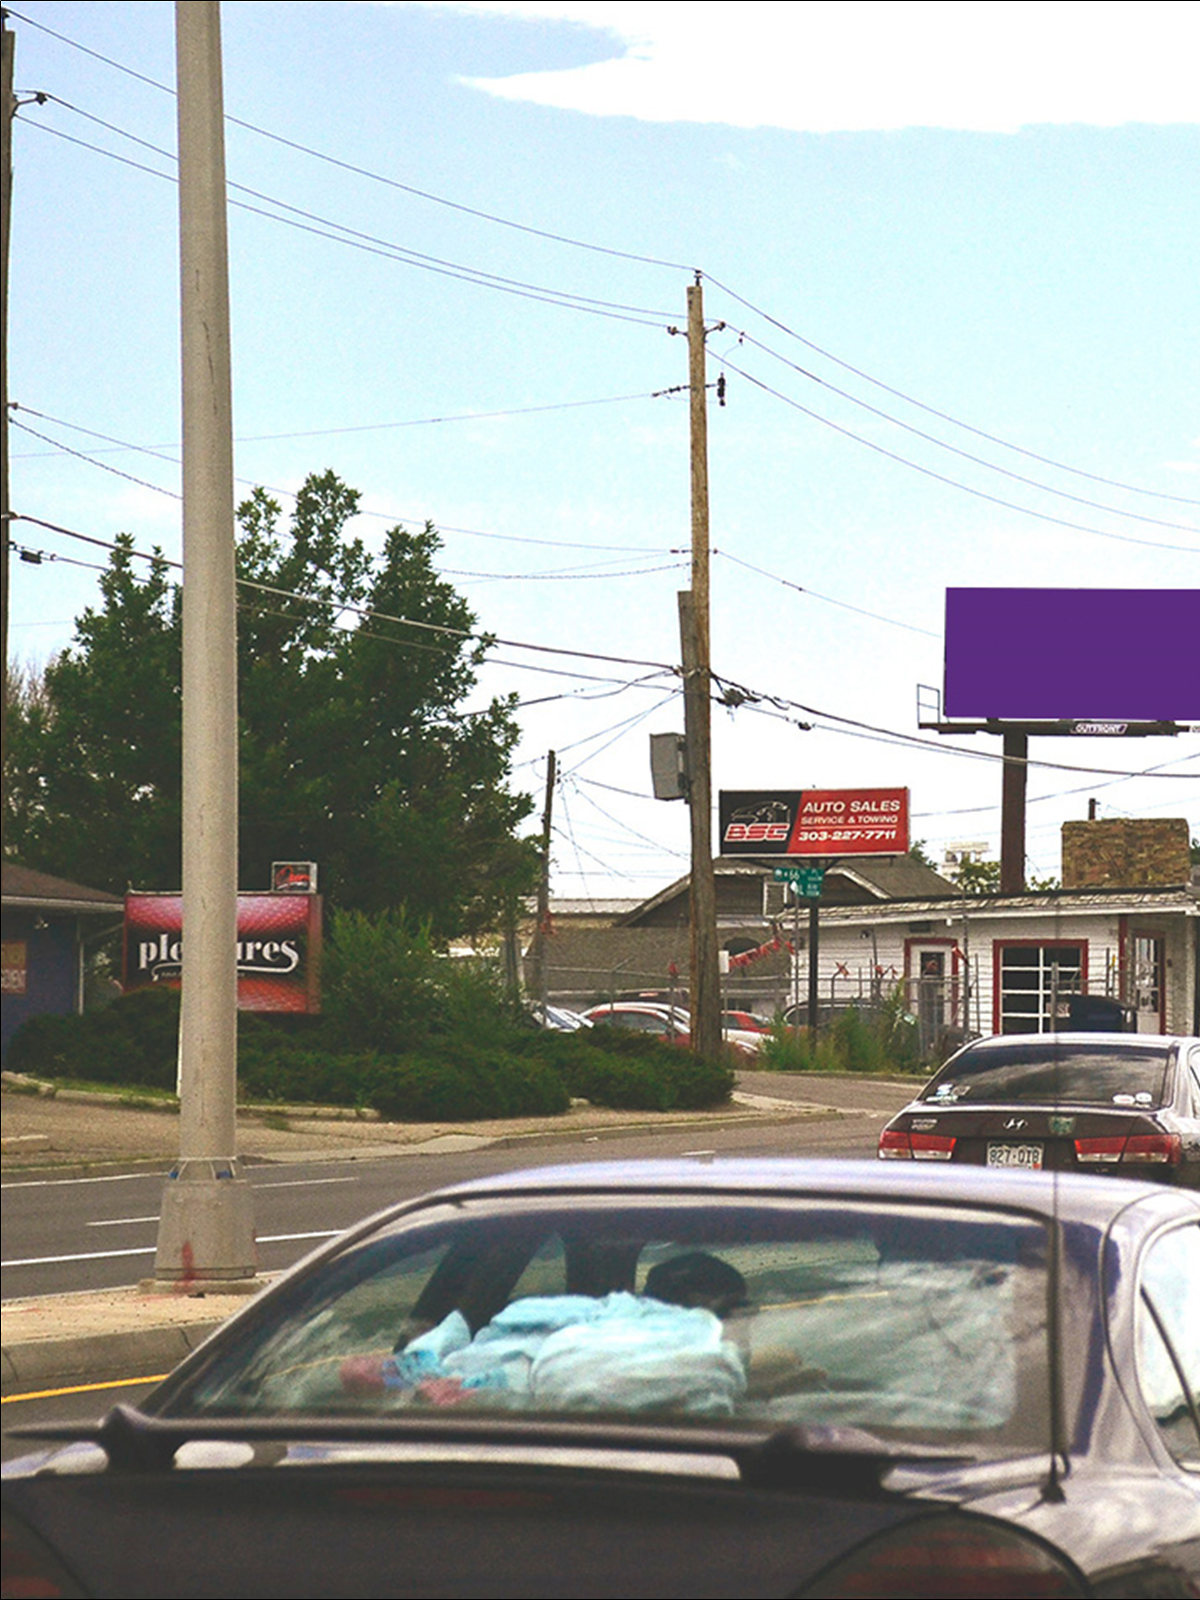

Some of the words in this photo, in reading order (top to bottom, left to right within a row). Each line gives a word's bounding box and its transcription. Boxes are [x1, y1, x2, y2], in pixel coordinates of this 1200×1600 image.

[803, 802, 846, 814] AUTO
[850, 800, 901, 812] SALES
[801, 816, 845, 825] SERVICE
[847, 816, 855, 824] &
[858, 815, 898, 824] TOWING
[724, 823, 791, 842] BSC
[799, 830, 897, 841] 303-227-7711
[139, 933, 299, 973] pleres
